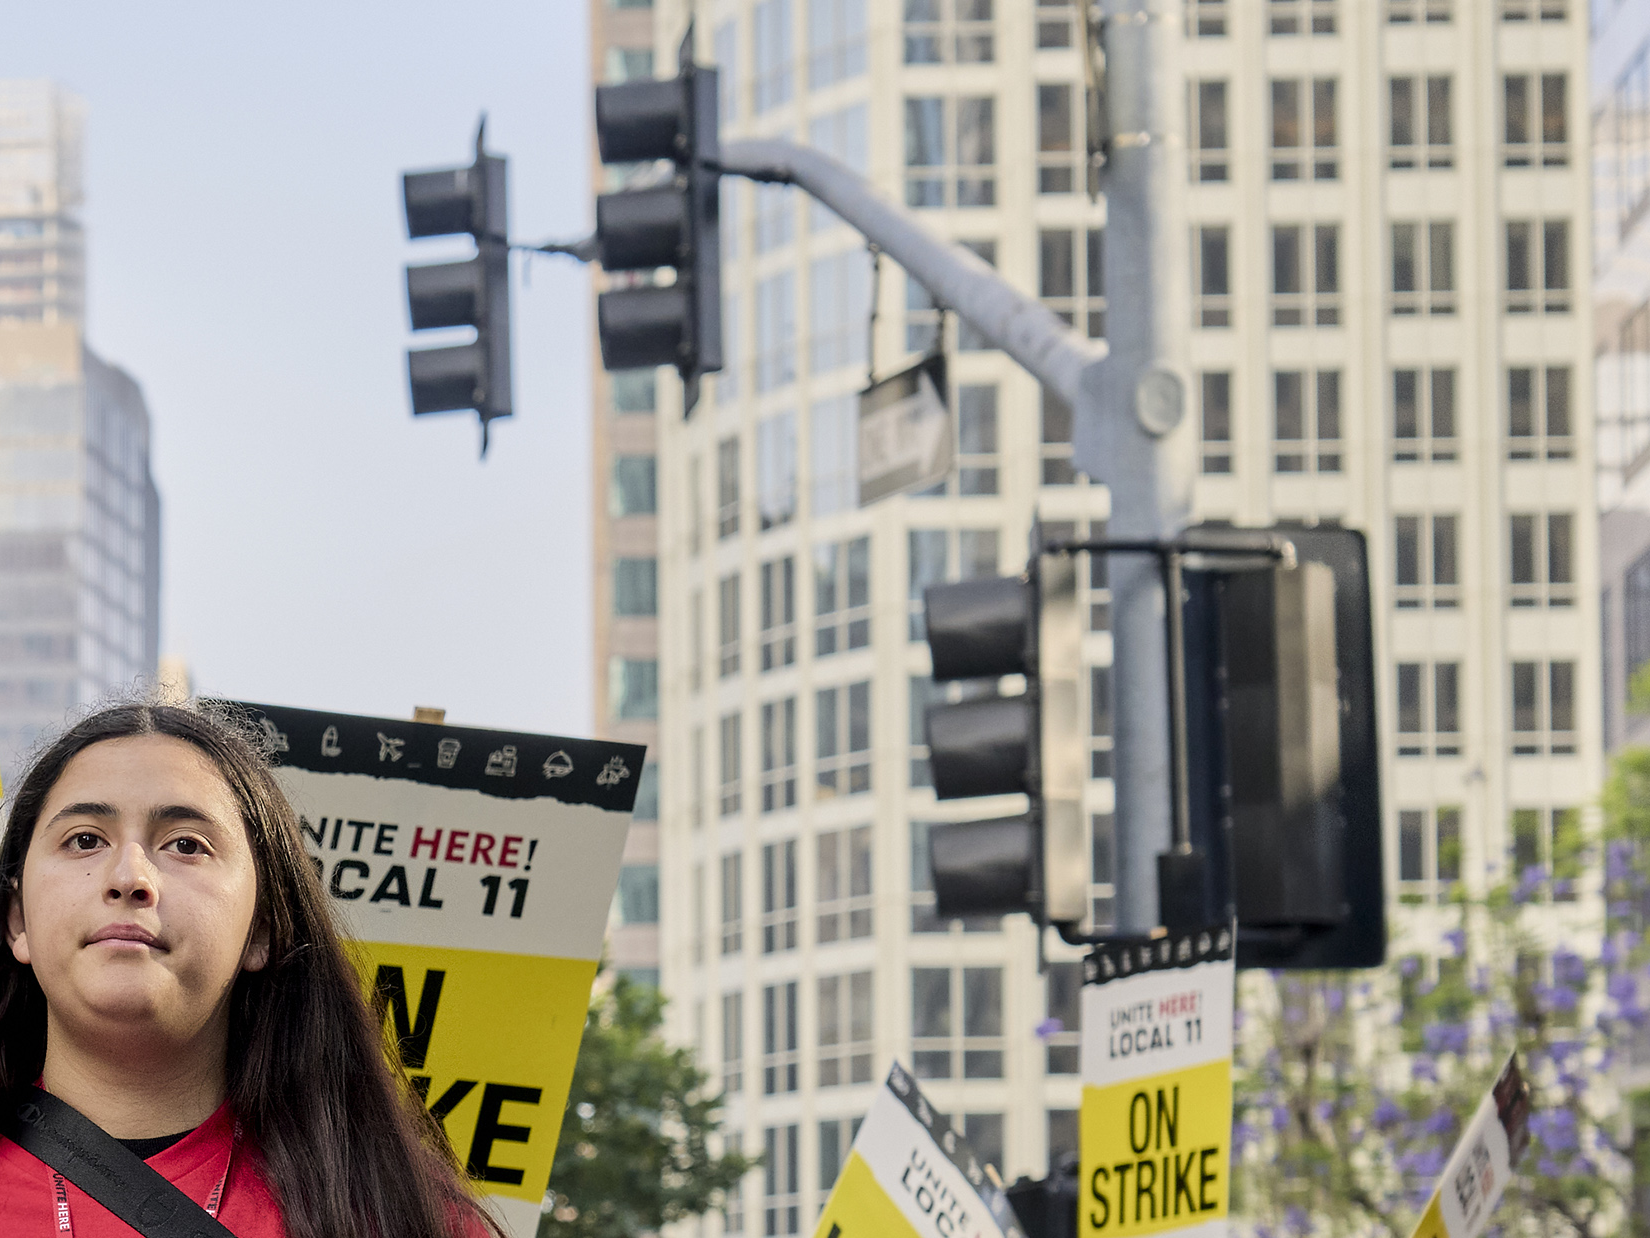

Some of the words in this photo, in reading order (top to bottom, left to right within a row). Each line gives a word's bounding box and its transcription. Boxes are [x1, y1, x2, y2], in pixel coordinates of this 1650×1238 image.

[300, 815, 399, 857] NITE
[409, 826, 539, 872] HERE!
[310, 856, 444, 909] CAL
[480, 875, 530, 918] 11
[371, 964, 447, 1070] N
[1109, 1023, 1174, 1058] LOCAL
[1186, 1018, 1202, 1043] 11
[1129, 1084, 1180, 1154] ON
[911, 1148, 970, 1232] UNITE
[1090, 1148, 1219, 1230] STRIKE
